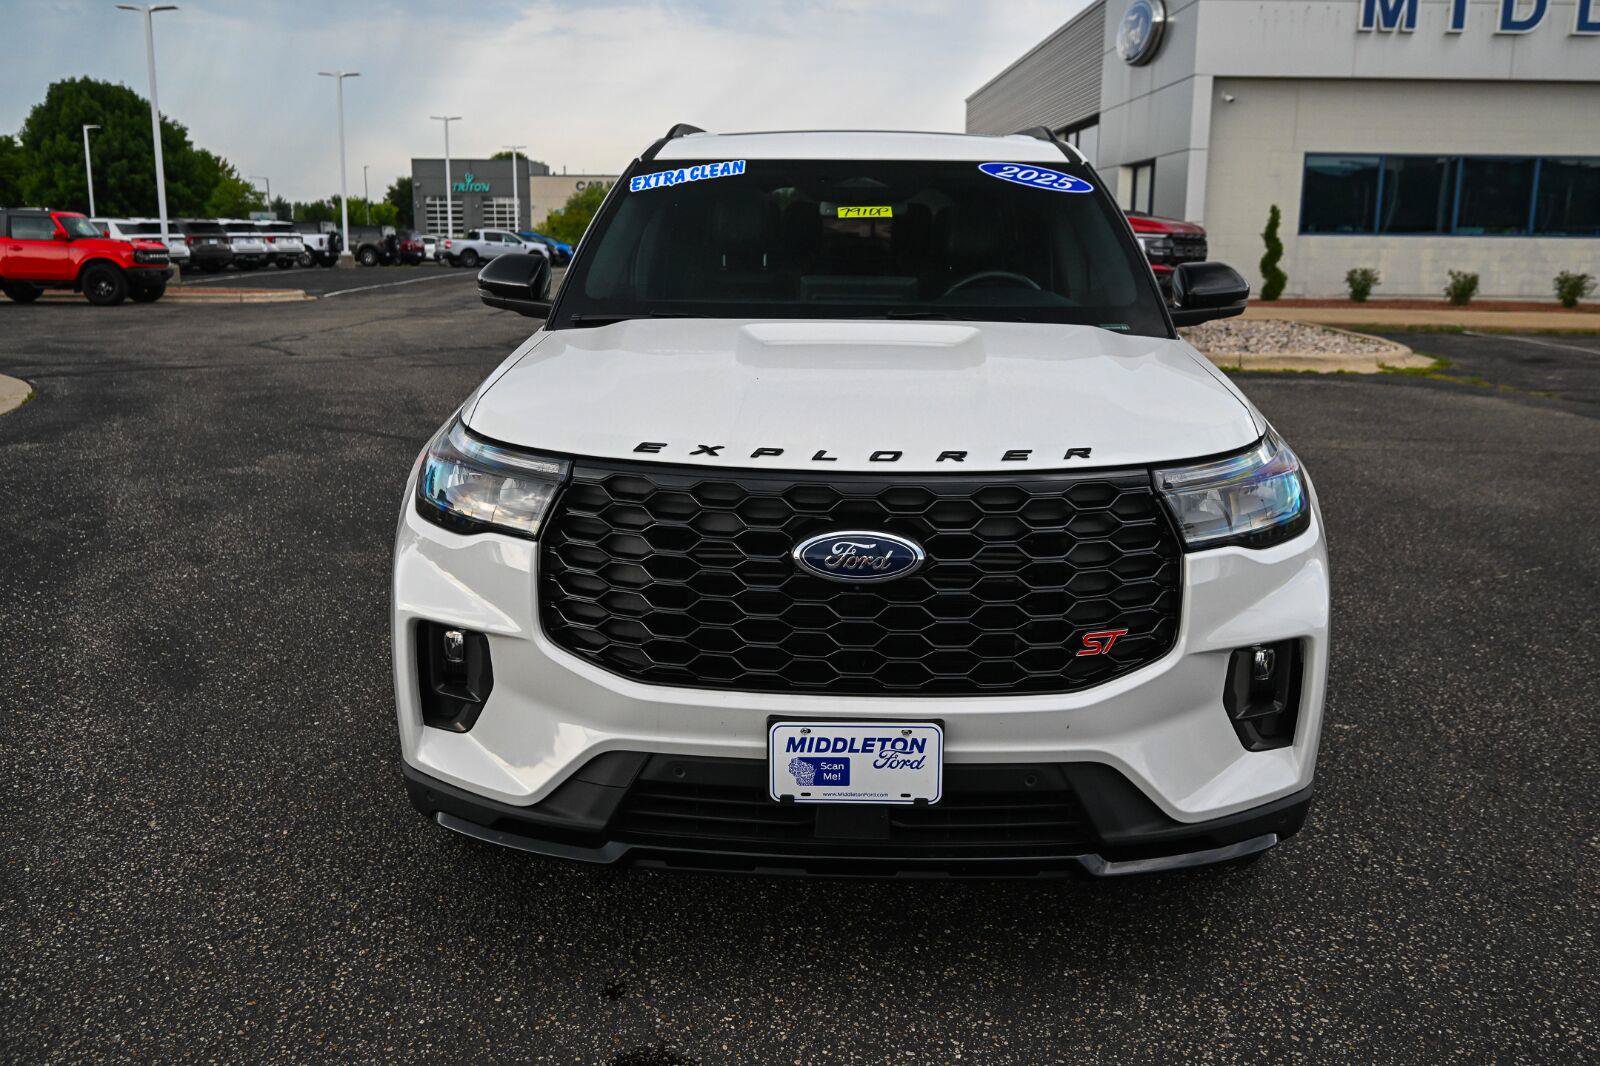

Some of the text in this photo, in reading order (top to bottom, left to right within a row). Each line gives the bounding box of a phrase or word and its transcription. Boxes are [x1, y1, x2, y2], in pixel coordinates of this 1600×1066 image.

[1357, 0, 1600, 33] MID
[630, 169, 686, 191] EXTRA
[689, 160, 745, 180] CLEAN
[995, 166, 1077, 189] 2025
[632, 441, 1092, 462] EXPLORER
[824, 541, 893, 570] Ford
[1075, 628, 1128, 656] ST
[785, 736, 927, 754] MIDDLETON
[820, 762, 845, 770] Scan
[872, 749, 926, 770] Ford
[823, 772, 841, 780] Me!
